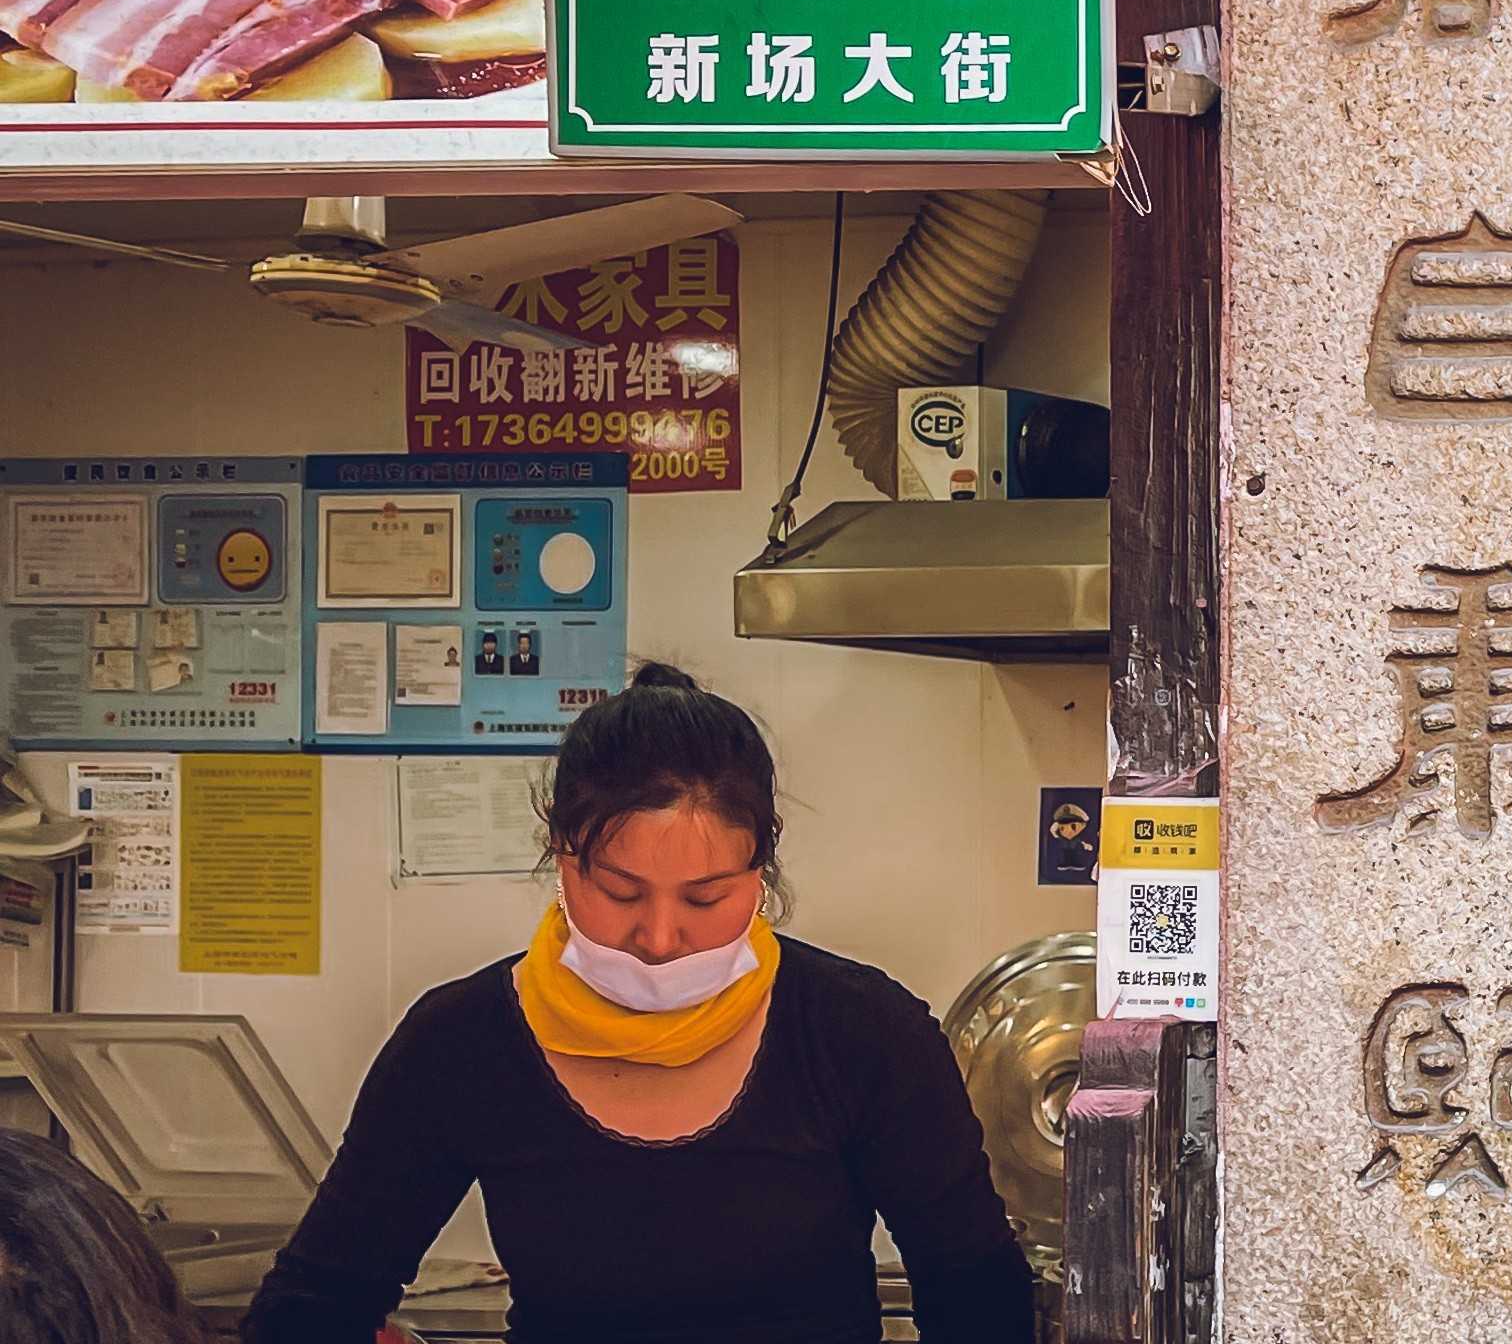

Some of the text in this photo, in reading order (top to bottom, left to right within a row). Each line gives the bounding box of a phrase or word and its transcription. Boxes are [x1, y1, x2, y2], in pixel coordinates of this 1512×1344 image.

[646, 32, 1011, 104] 新场大街
[917, 414, 964, 434] CEP
[1117, 971, 1207, 987] 在此扫码付款
